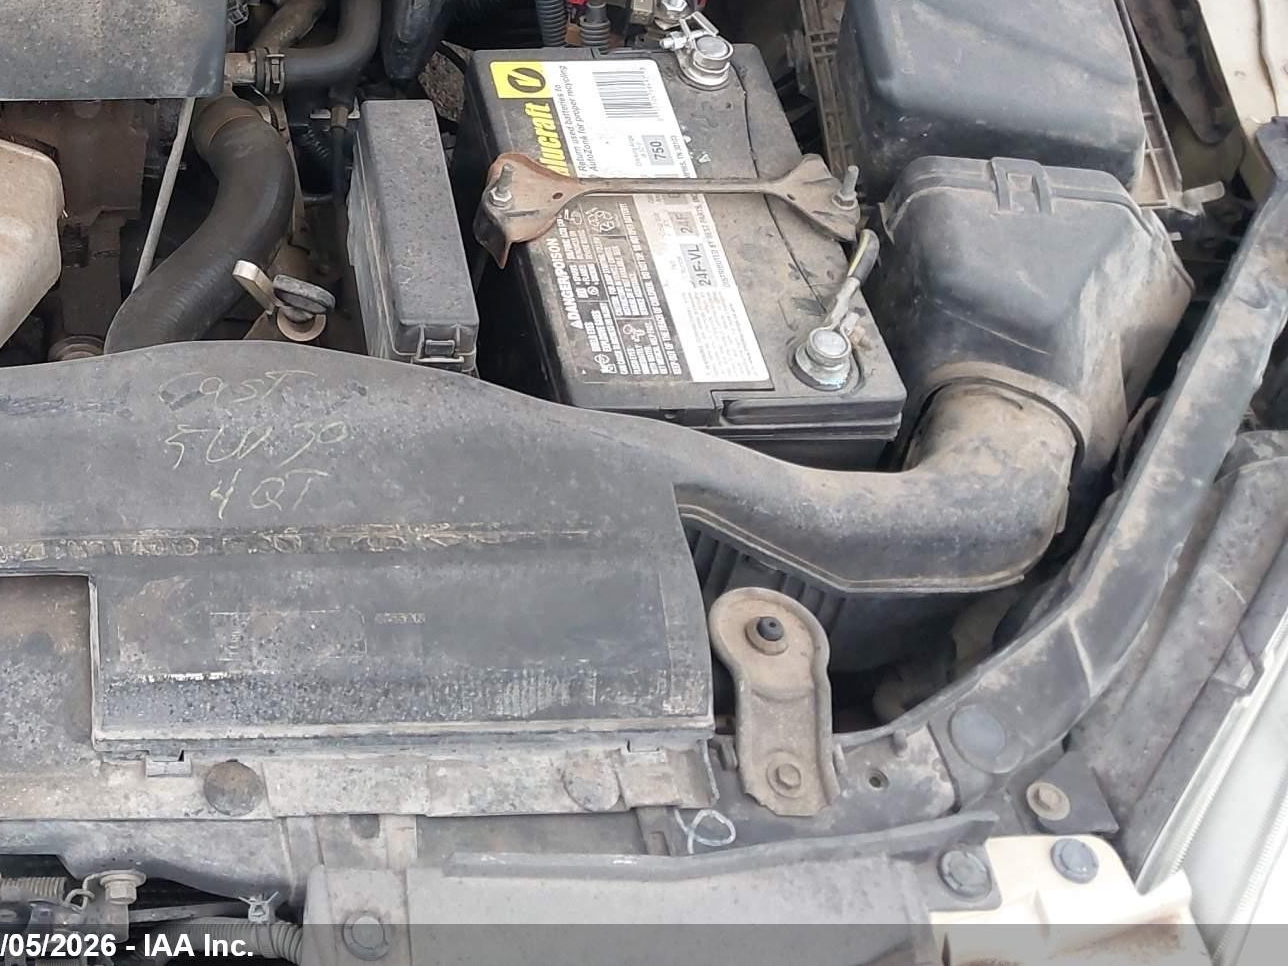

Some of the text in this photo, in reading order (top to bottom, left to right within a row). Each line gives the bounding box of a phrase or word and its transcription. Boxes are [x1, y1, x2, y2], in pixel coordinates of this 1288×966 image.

[555, 93, 573, 124] batteries
[568, 98, 584, 122] proper
[522, 102, 570, 176] alucraft
[566, 126, 579, 143] used
[575, 123, 586, 133] for
[572, 146, 587, 171] Return
[649, 141, 666, 159] 750
[545, 237, 580, 320] DANGER/POISON
[685, 244, 712, 285] 24F-VL
[209, 468, 331, 521] 4 QT
